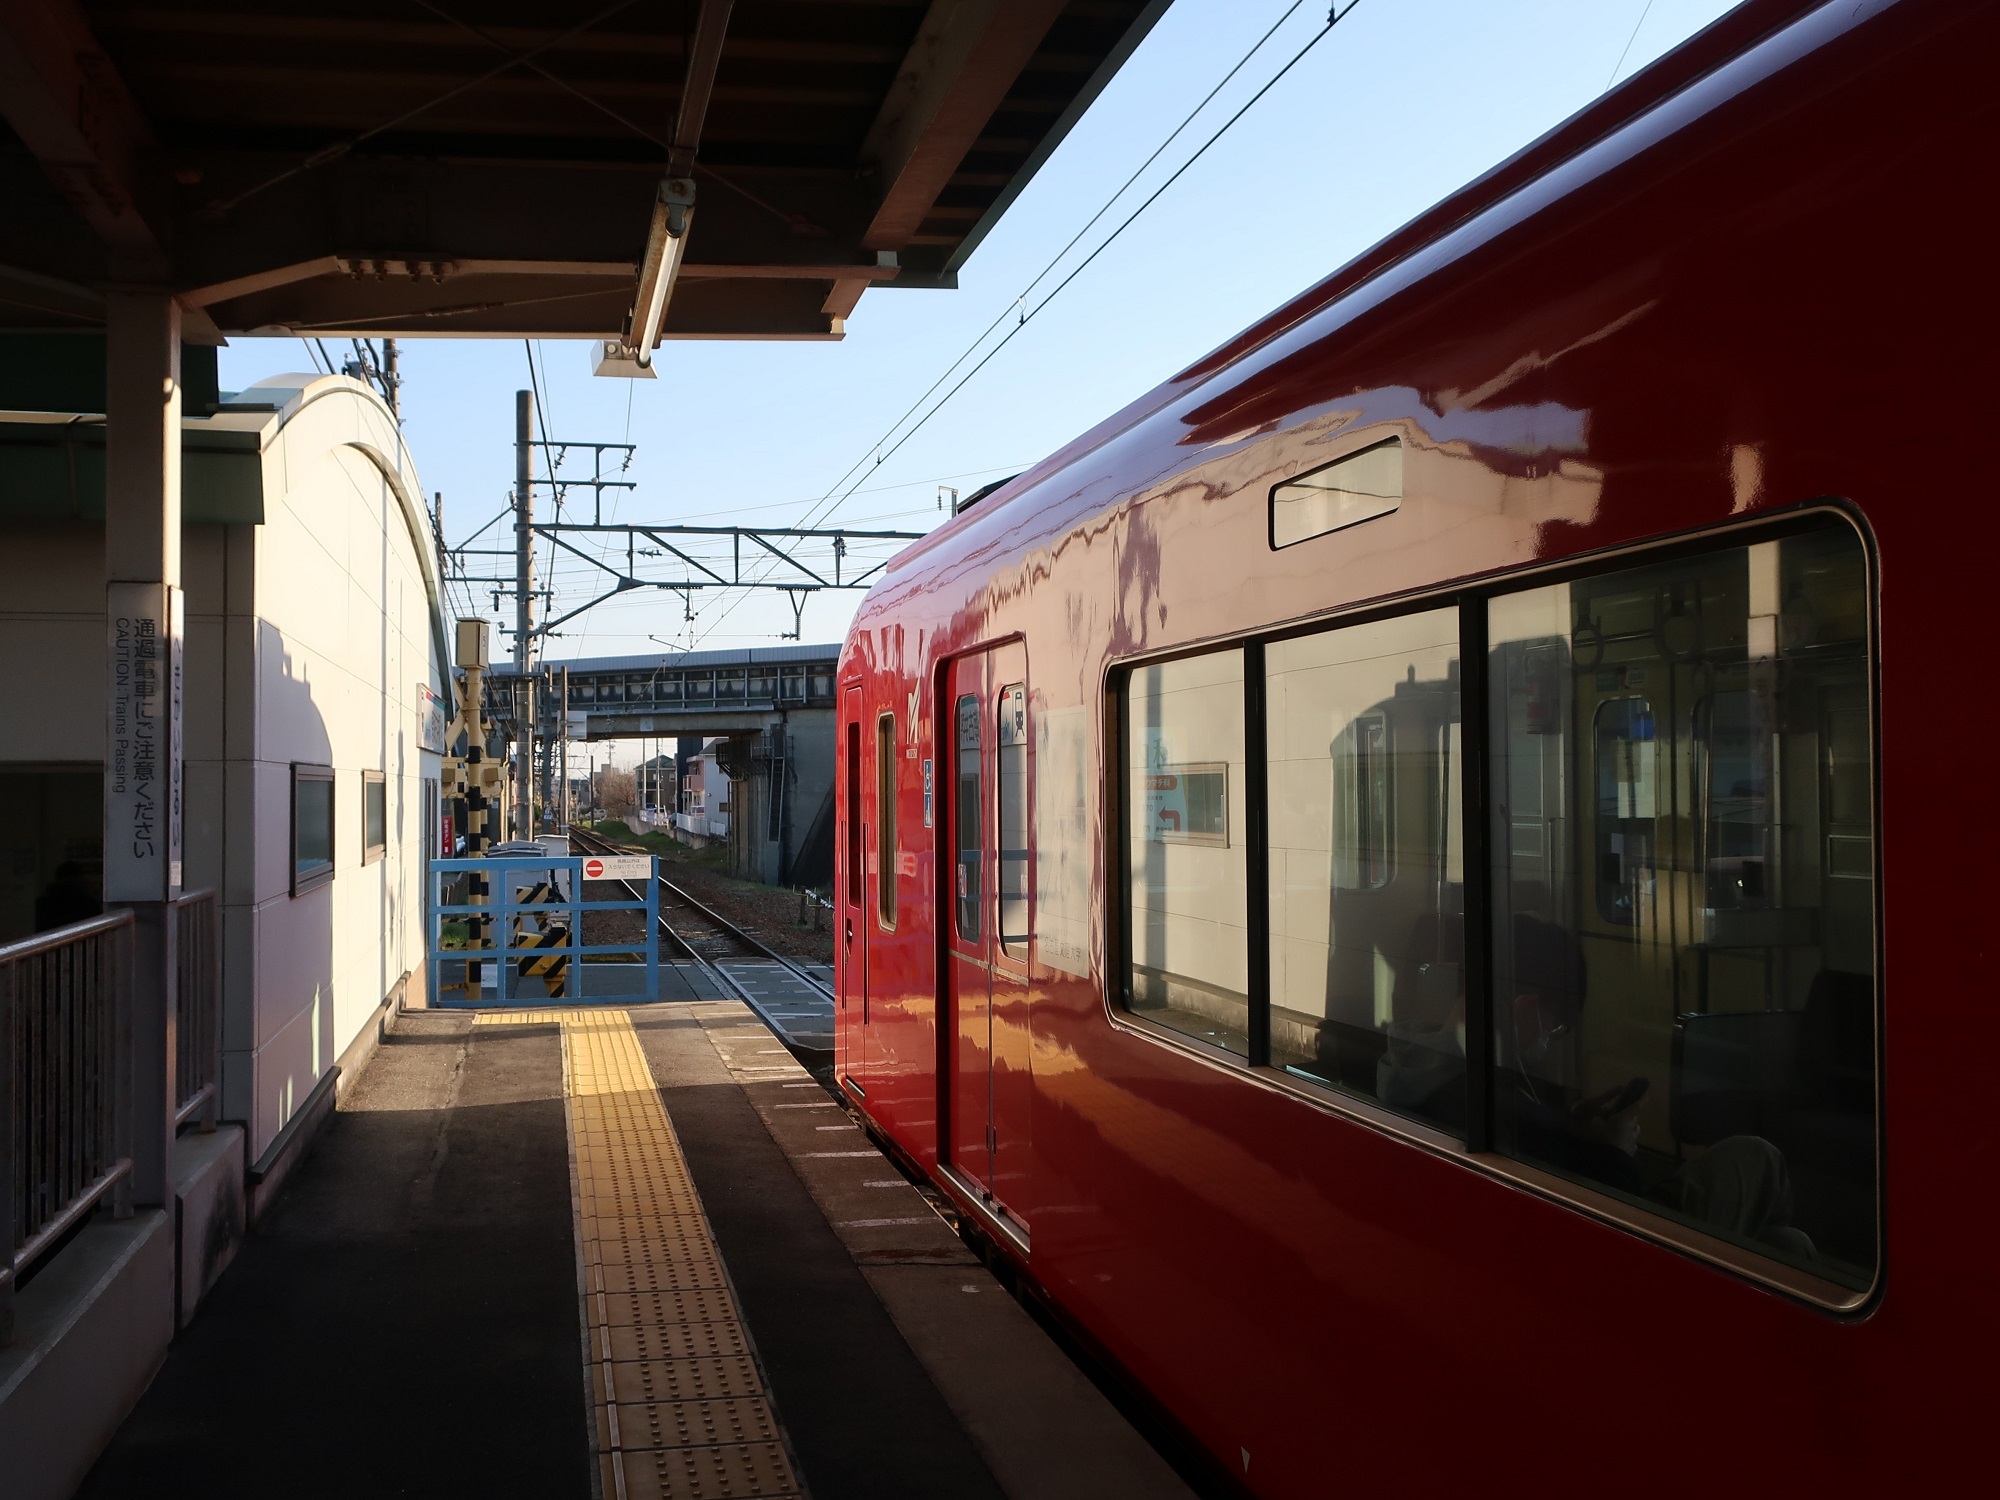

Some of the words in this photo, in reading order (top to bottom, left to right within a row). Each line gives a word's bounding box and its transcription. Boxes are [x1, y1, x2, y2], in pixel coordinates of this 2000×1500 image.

[115, 694, 130, 734] Trains
[132, 618, 156, 859] 通過電車にご注意ください
[111, 739, 129, 793] Passing
